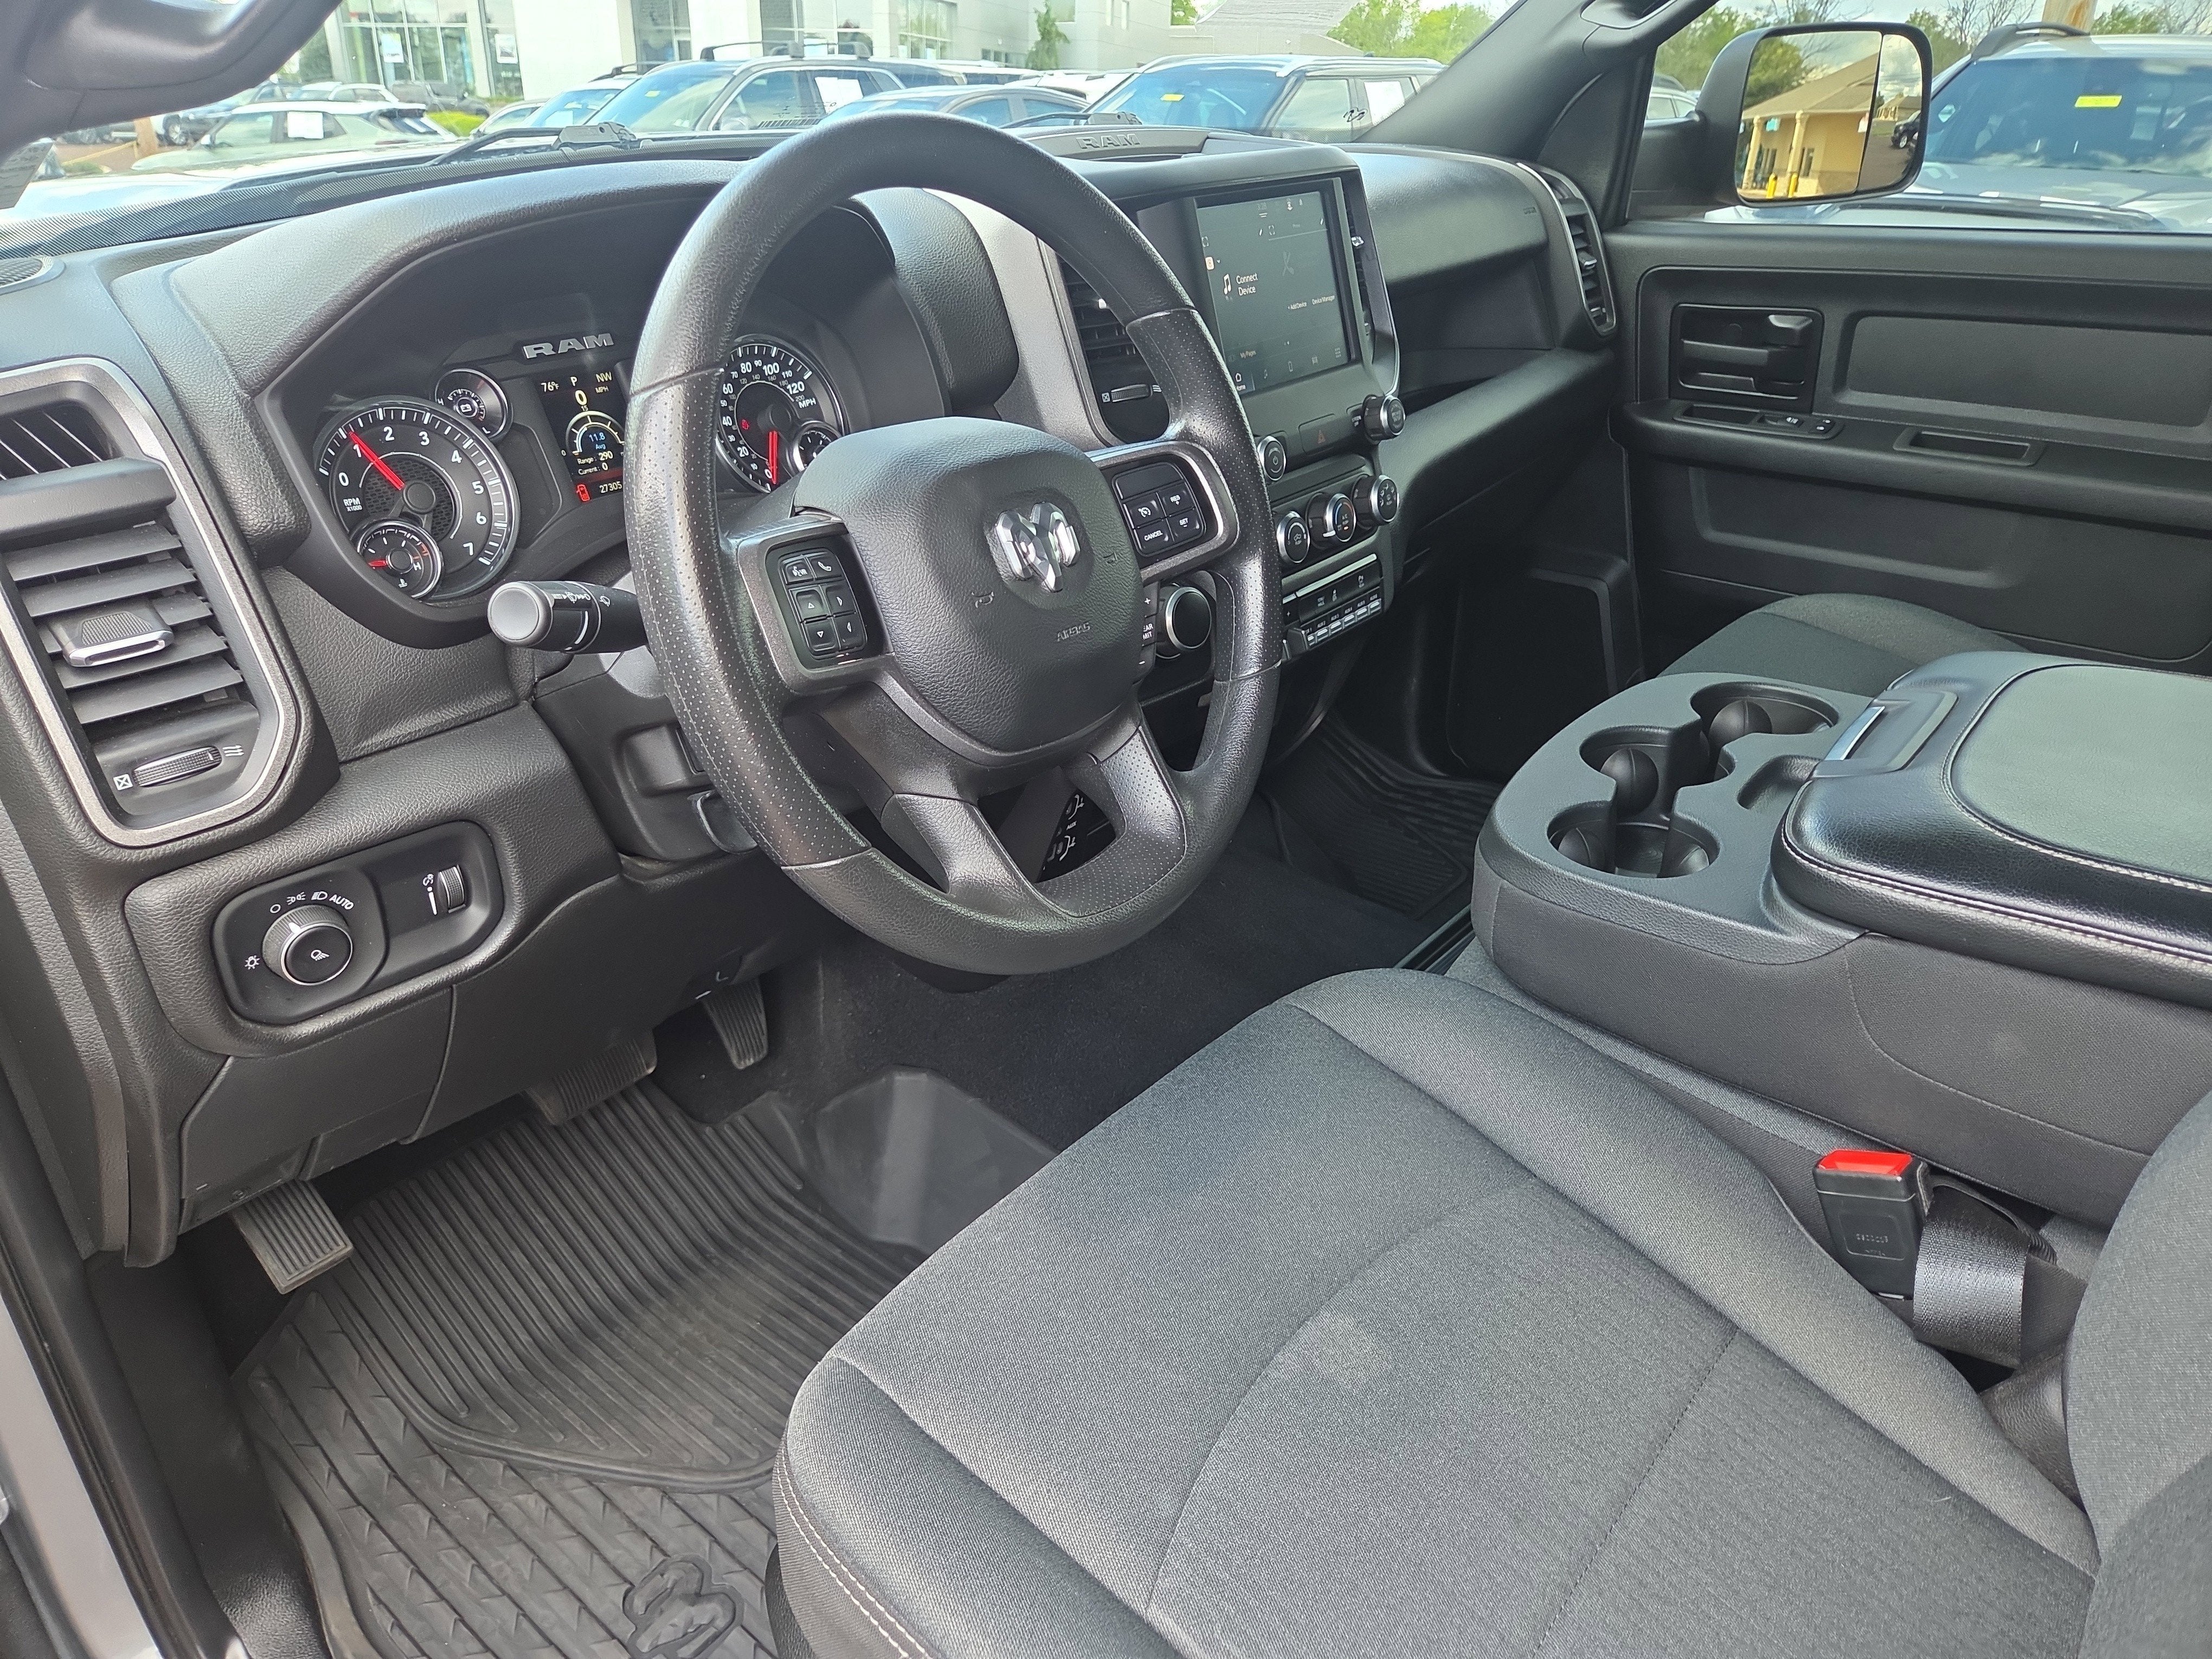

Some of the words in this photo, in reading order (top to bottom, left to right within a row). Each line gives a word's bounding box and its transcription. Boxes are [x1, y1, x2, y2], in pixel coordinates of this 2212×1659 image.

[1076, 133, 1141, 150] RAM
[1236, 273, 1258, 284] Connect
[1238, 285, 1256, 296] Device
[523, 333, 614, 358] RAM
[740, 362, 752, 374] 80
[763, 362, 780, 376] 100
[596, 371, 613, 382] NW
[730, 371, 738, 380] 70
[782, 370, 793, 378] 110
[570, 376, 578, 386] P
[723, 383, 734, 395] 60
[787, 381, 805, 395] 120
[575, 390, 587, 406] 0
[798, 397, 816, 408] MPH
[723, 416, 732, 426] 40
[383, 427, 395, 441] 2
[419, 431, 430, 445] 3
[589, 432, 606, 442] 11.8
[353, 444, 361, 457] 1
[598, 451, 613, 461] 290
[737, 446, 749, 457] 20
[451, 450, 462, 464] 4
[602, 462, 608, 471] 0
[338, 472, 349, 486] 0
[764, 468, 773, 479] 0
[472, 480, 484, 494] 5
[599, 481, 623, 493] 27305
[343, 497, 361, 506] RPM
[1170, 494, 1181, 503] RES
[476, 511, 487, 525] 6
[1179, 517, 1189, 526] SET
[1144, 530, 1163, 541] CANCEL
[464, 543, 474, 556] 7
[414, 562, 421, 570] H
[1142, 631, 1152, 640] MIT
[329, 894, 354, 910] AUTO
